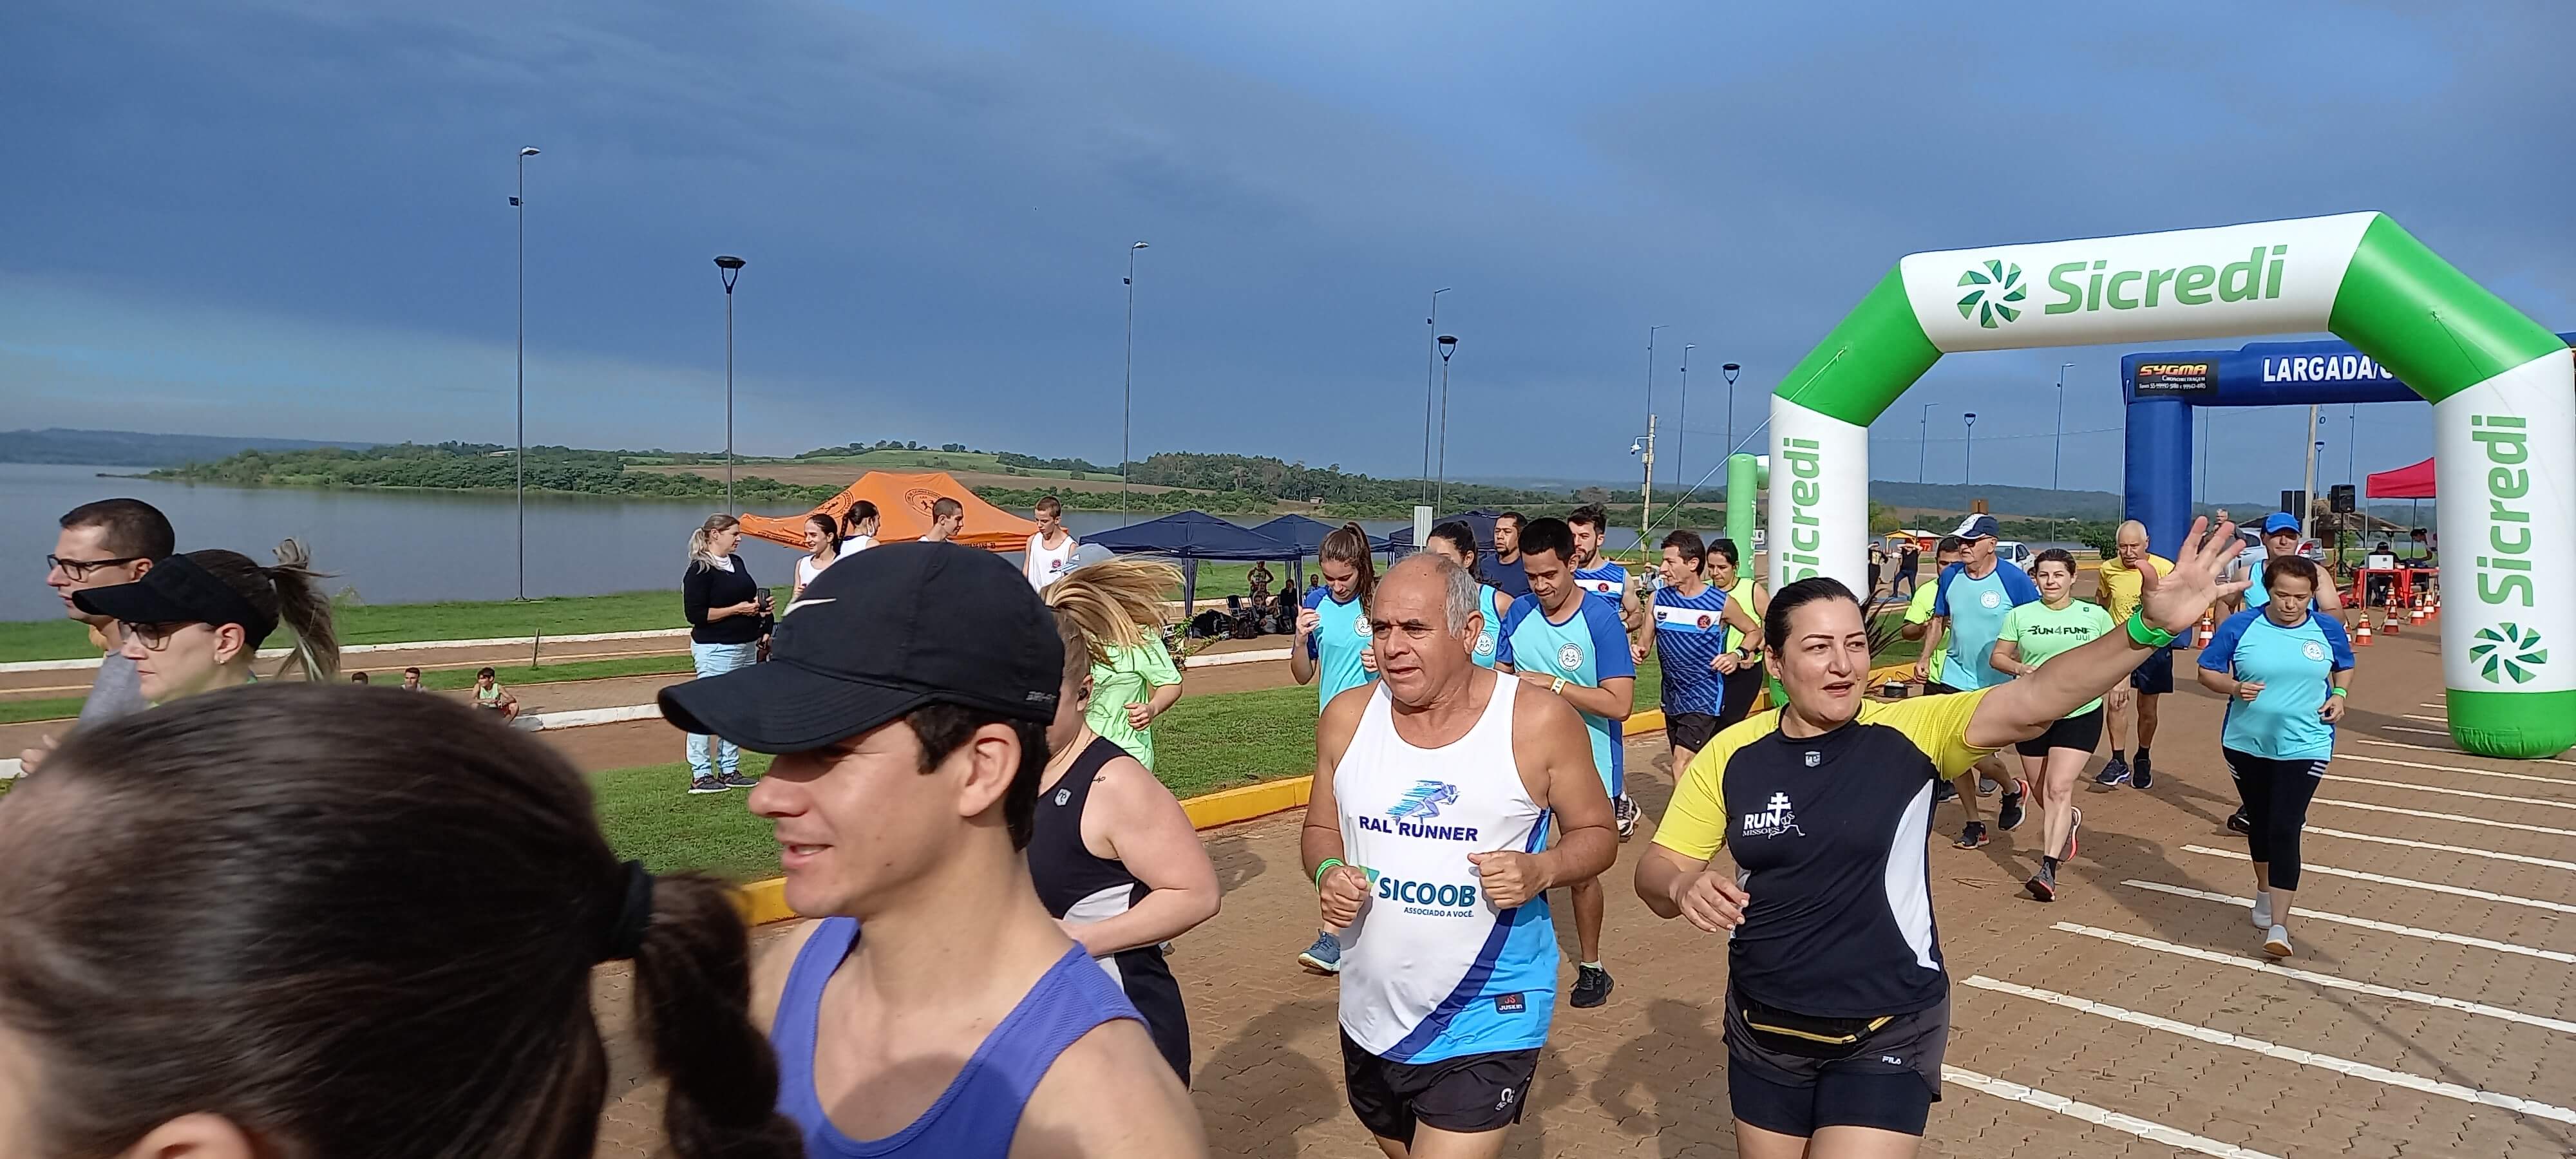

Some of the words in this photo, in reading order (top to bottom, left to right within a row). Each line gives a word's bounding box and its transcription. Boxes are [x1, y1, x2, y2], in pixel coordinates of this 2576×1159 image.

[2045, 245, 2287, 314] Sicredi
[2139, 364, 2207, 375] SYGMA
[2472, 415, 2533, 607] Sicredi
[1359, 815, 1392, 834] RAL
[1399, 822, 1479, 842] RUNNER
[1743, 812, 1781, 830] RUN
[1378, 877, 1476, 907] SICOOB
[1404, 907, 1445, 917] ASSOCIADO
[1882, 1055, 1902, 1065] FILA
